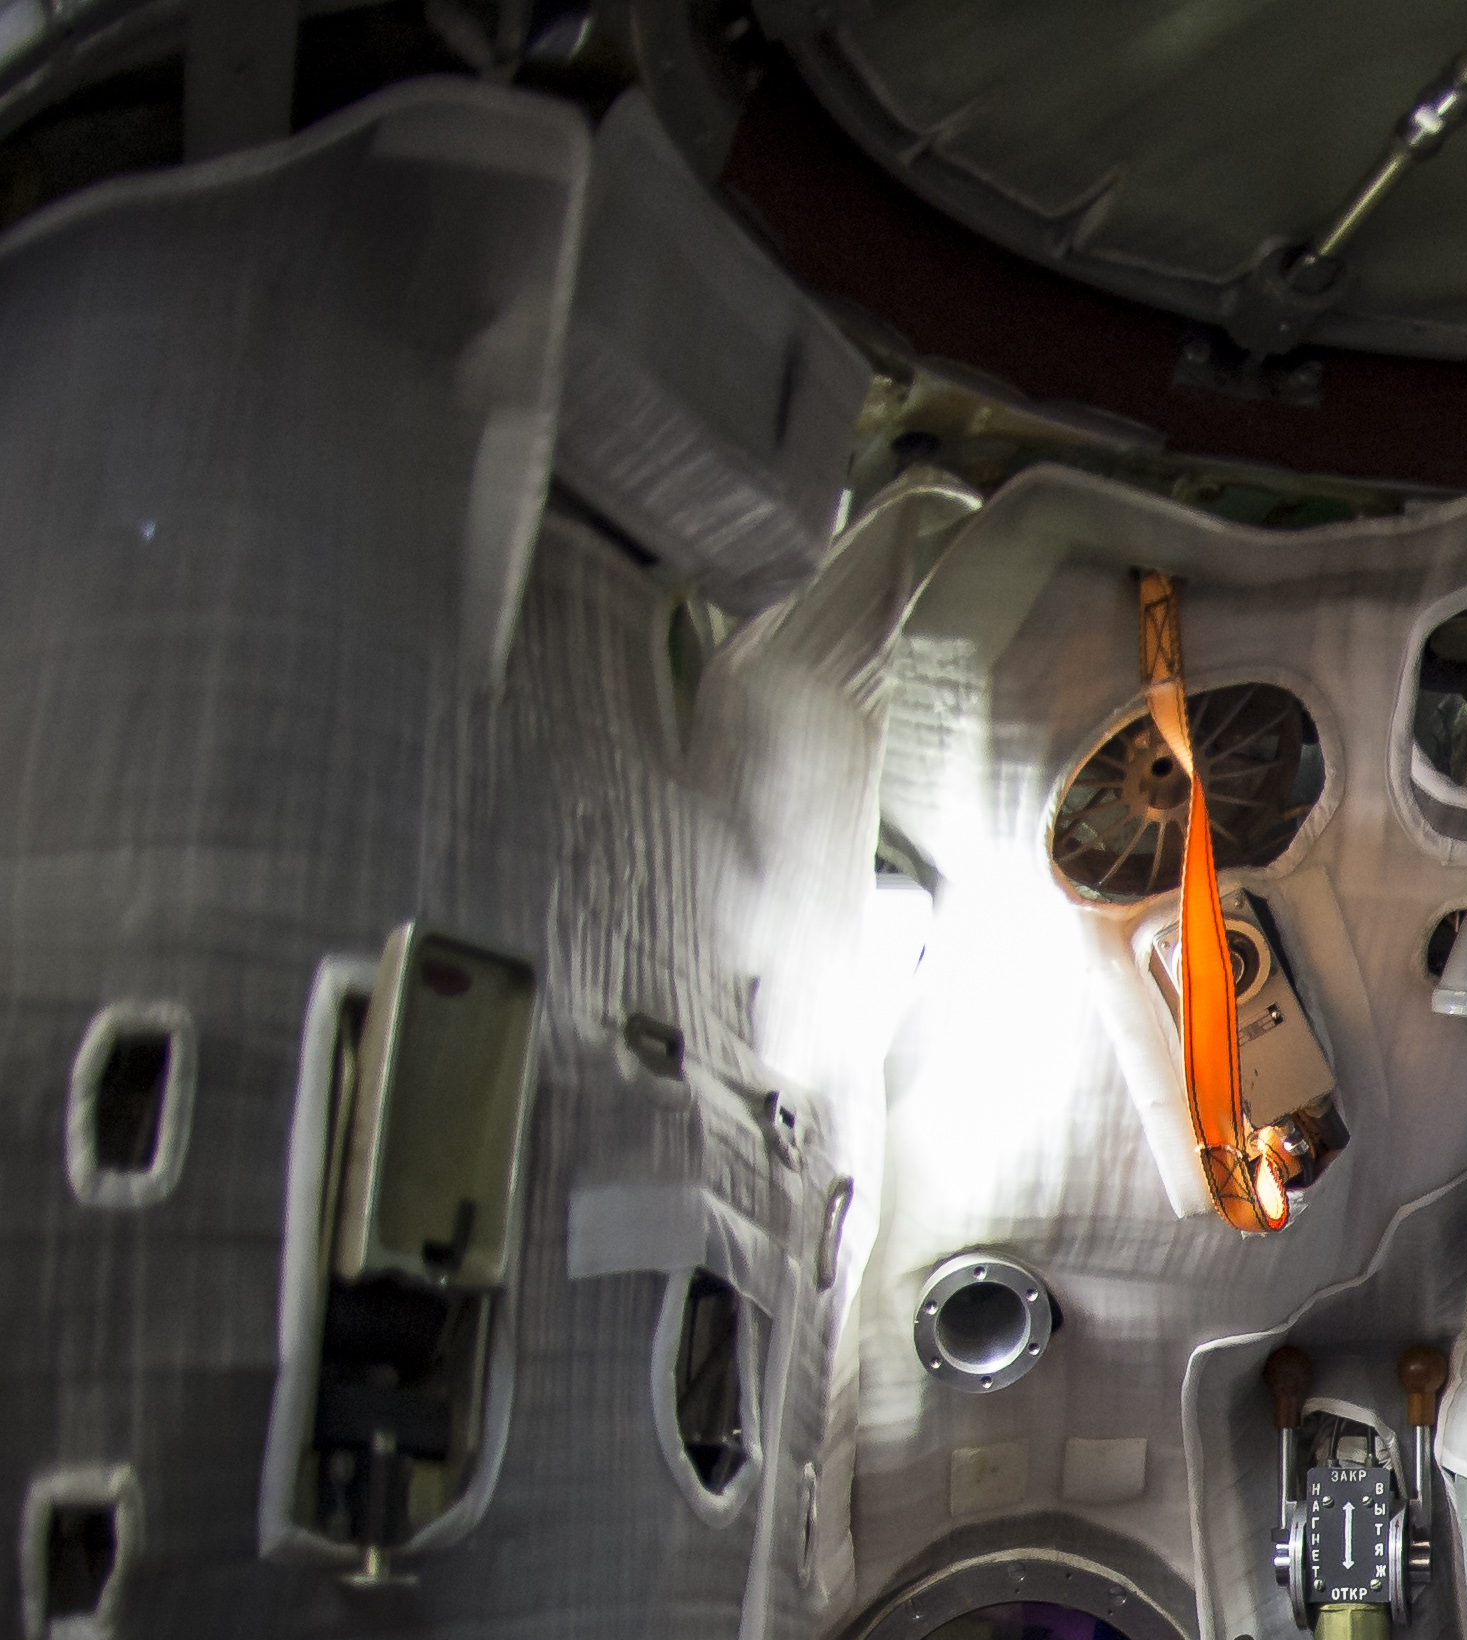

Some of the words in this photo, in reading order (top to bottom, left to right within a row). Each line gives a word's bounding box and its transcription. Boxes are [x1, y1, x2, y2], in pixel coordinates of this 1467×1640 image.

[1331, 1468, 1367, 1483] ЗАКР
[1311, 1482, 1321, 1577] НАГНЕТ
[1373, 1482, 1387, 1578] ВЫТЯЖ
[1331, 1586, 1368, 1601] ОТКР
